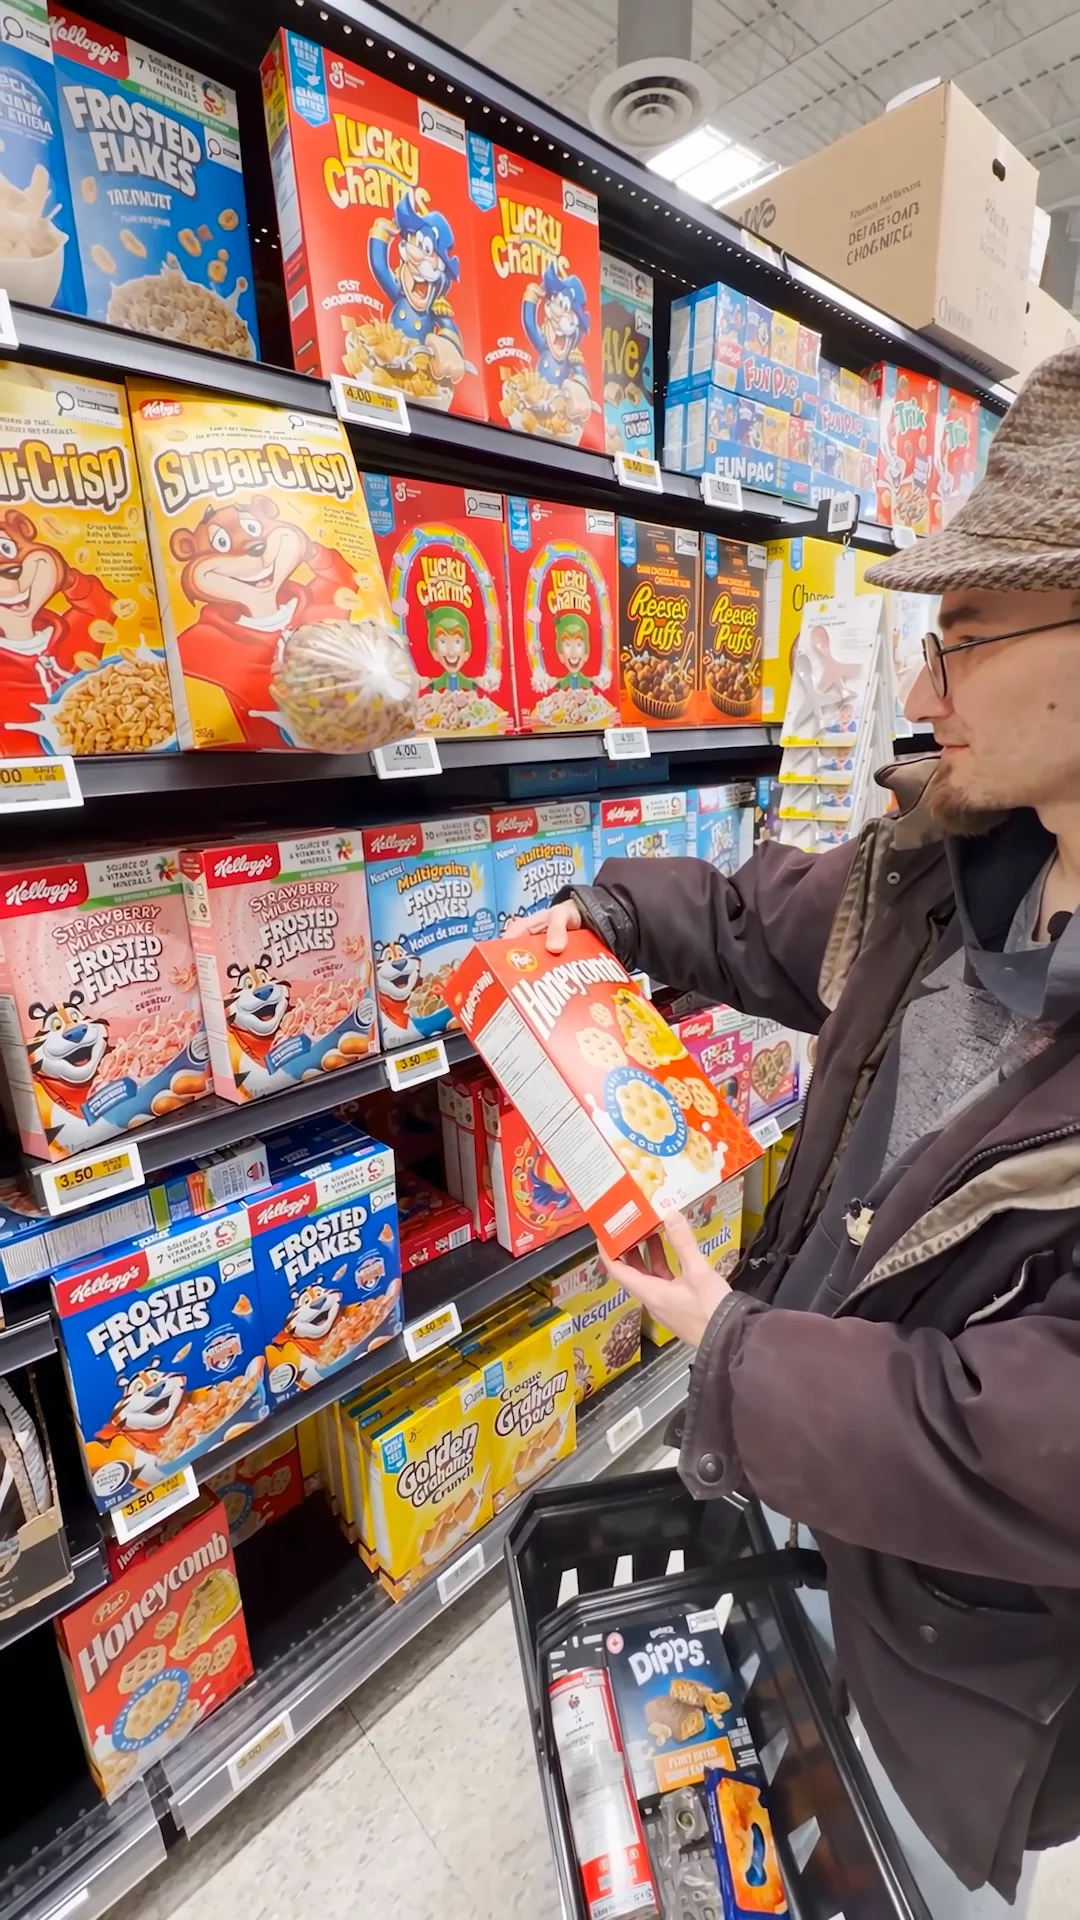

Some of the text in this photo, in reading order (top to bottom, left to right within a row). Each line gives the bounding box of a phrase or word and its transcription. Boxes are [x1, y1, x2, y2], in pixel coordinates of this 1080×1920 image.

[48, 14, 121, 66] Kellogg's
[62, 84, 203, 165] FROSTED
[89, 131, 198, 198] FLAKES
[333, 113, 420, 186] Lucky
[323, 156, 431, 217] Charms
[499, 197, 563, 256] Lucky
[491, 237, 570, 279] Charms
[601, 325, 640, 378] AVe
[346, 386, 372, 404] 4.00
[156, 444, 355, 514] Sugar-Crisp
[715, 456, 775, 484] FUN PAC
[420, 556, 467, 586] Lucky
[551, 569, 588, 597] Lucky
[416, 576, 473, 608] Charms
[547, 587, 593, 615] Charms
[630, 584, 689, 620] Reese's
[711, 594, 759, 626] Reese's
[636, 617, 684, 651] Puffs
[714, 623, 754, 654] Puffs
[395, 745, 418, 757] 4.00
[371, 835, 417, 854] Kellogg's
[515, 842, 573, 871] Multigrain
[213, 854, 272, 879] Kellogg's
[397, 861, 471, 895] Multigrains
[523, 859, 576, 892] FROSTED
[5, 878, 79, 907] Kellogg's
[249, 881, 340, 914] STRAWBERRY
[260, 894, 332, 924] MILKSHAKE
[404, 879, 473, 917] FROSTED
[52, 905, 161, 944] STRAWBERRY
[258, 907, 339, 950] FROSTED
[417, 898, 470, 930] FLAKES
[67, 921, 154, 956] MILKSHAKE
[271, 927, 336, 968] FLAKES
[64, 935, 163, 985] FROSTED
[82, 957, 160, 1005] FLAKES
[511, 952, 630, 1041] Honeycomb
[60, 1166, 93, 1188] 3.50
[257, 1193, 311, 1226] Kellogg's
[268, 1206, 368, 1271] FROSTED
[284, 1229, 363, 1288] FLAKES
[69, 1266, 141, 1305] Kellogg's
[87, 1275, 217, 1357] FROSTED
[571, 1287, 631, 1333] Nesquik
[108, 1302, 211, 1373] FLAKES
[494, 1369, 569, 1437] Graham
[396, 1422, 480, 1499] Golden
[411, 1446, 474, 1508] Grahams
[126, 1490, 155, 1516] 3.50
[77, 1531, 229, 1694] Honeycomb
[627, 1637, 706, 1687] Dipps
